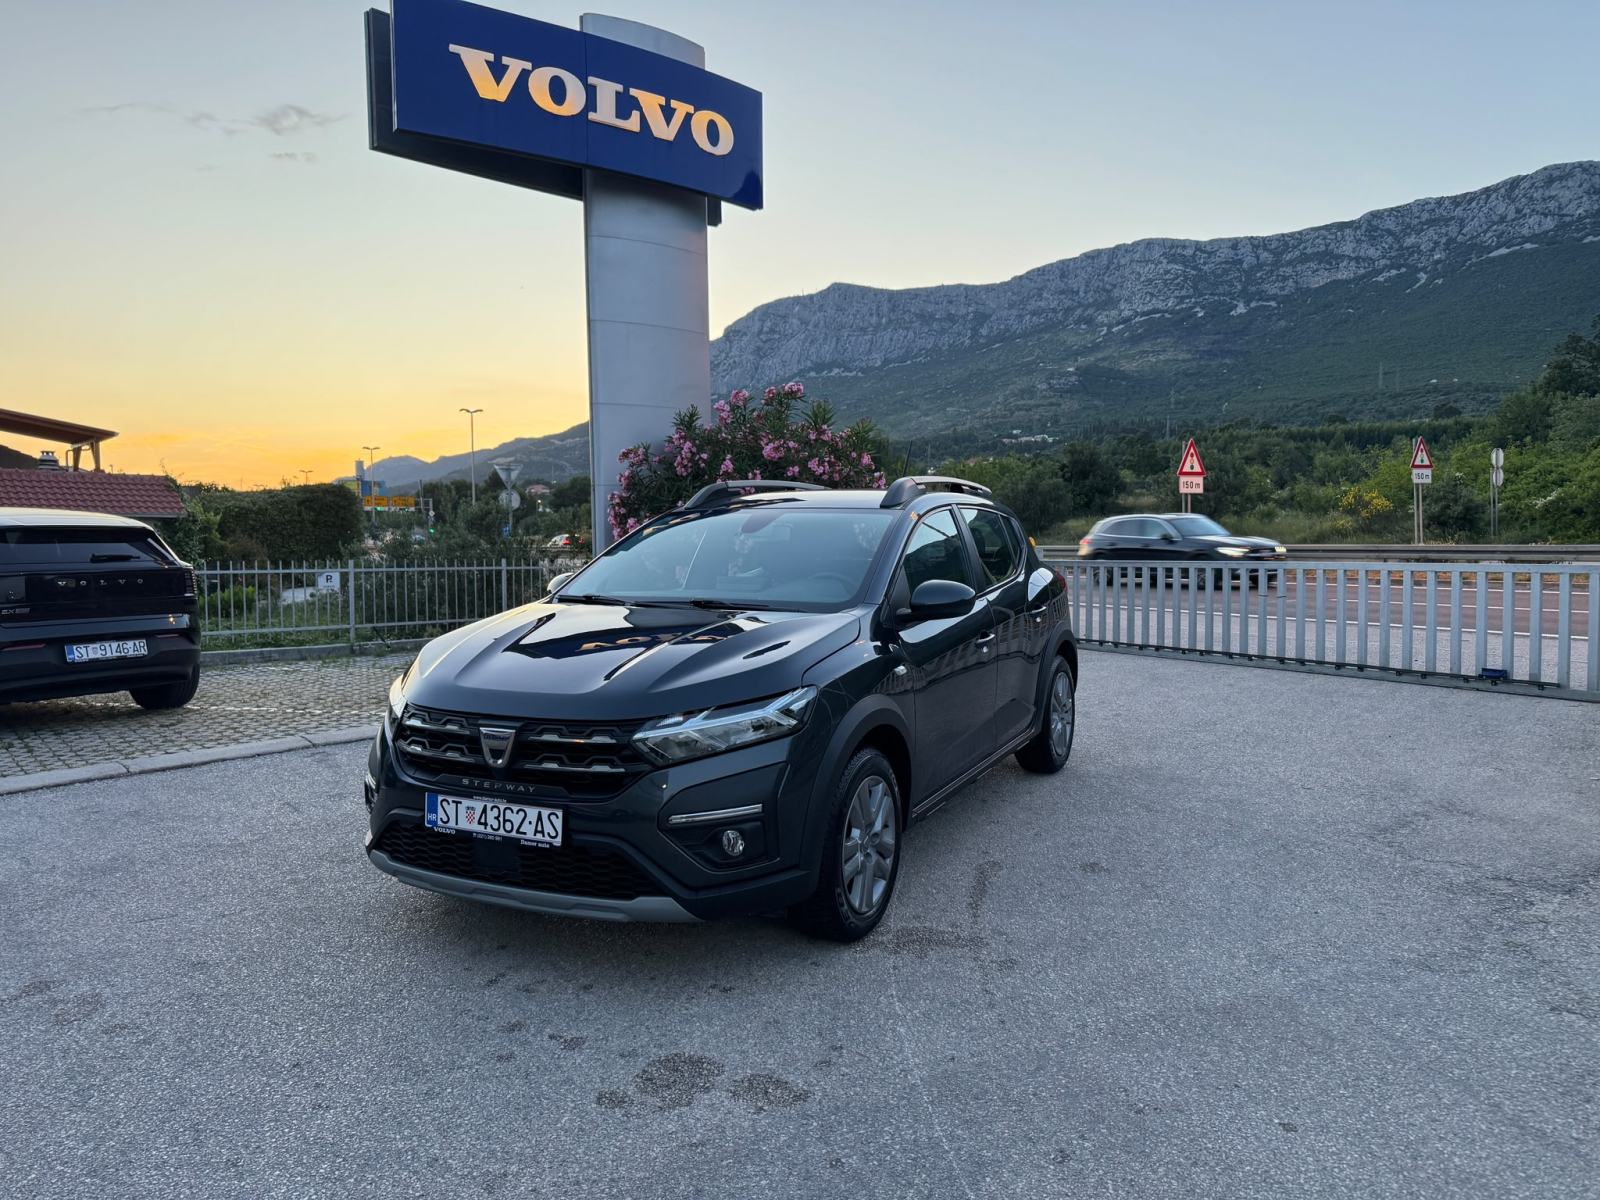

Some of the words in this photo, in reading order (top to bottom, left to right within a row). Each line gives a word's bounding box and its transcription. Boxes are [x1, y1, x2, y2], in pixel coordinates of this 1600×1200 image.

[449, 44, 734, 156] VOLVO
[1182, 481, 1193, 489] 150
[57, 578, 144, 587] VOLVO
[75, 645, 91, 659] ST
[462, 778, 536, 793] STEPWAY
[427, 812, 437, 822] HR
[440, 798, 462, 826] ST
[433, 826, 456, 835] VOLVO
